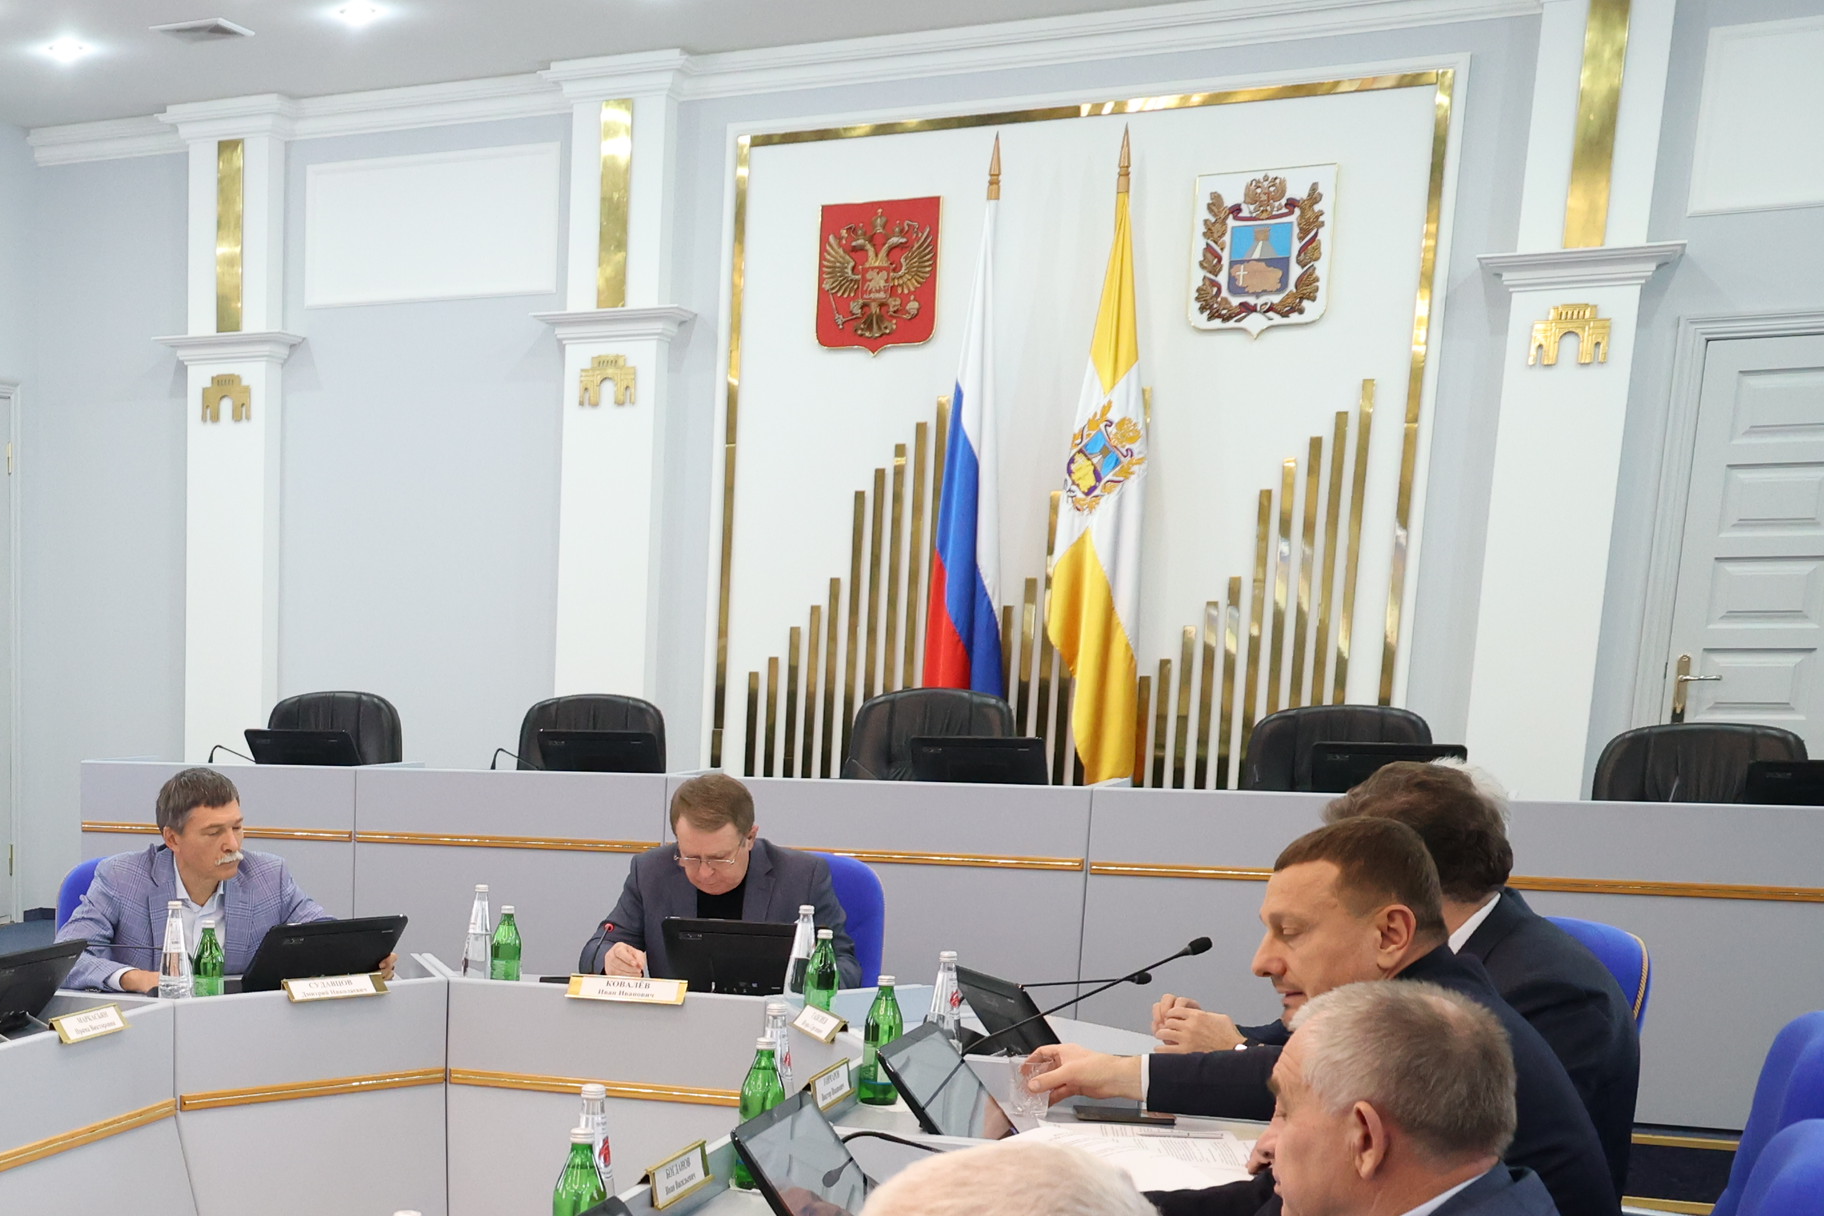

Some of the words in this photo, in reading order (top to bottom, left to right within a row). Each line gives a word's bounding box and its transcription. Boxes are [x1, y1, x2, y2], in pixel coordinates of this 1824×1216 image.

[308, 980, 353, 989] СУДАВЦОВ
[605, 980, 651, 989] КОВАЛЁВ
[618, 990, 655, 998] Иванович
